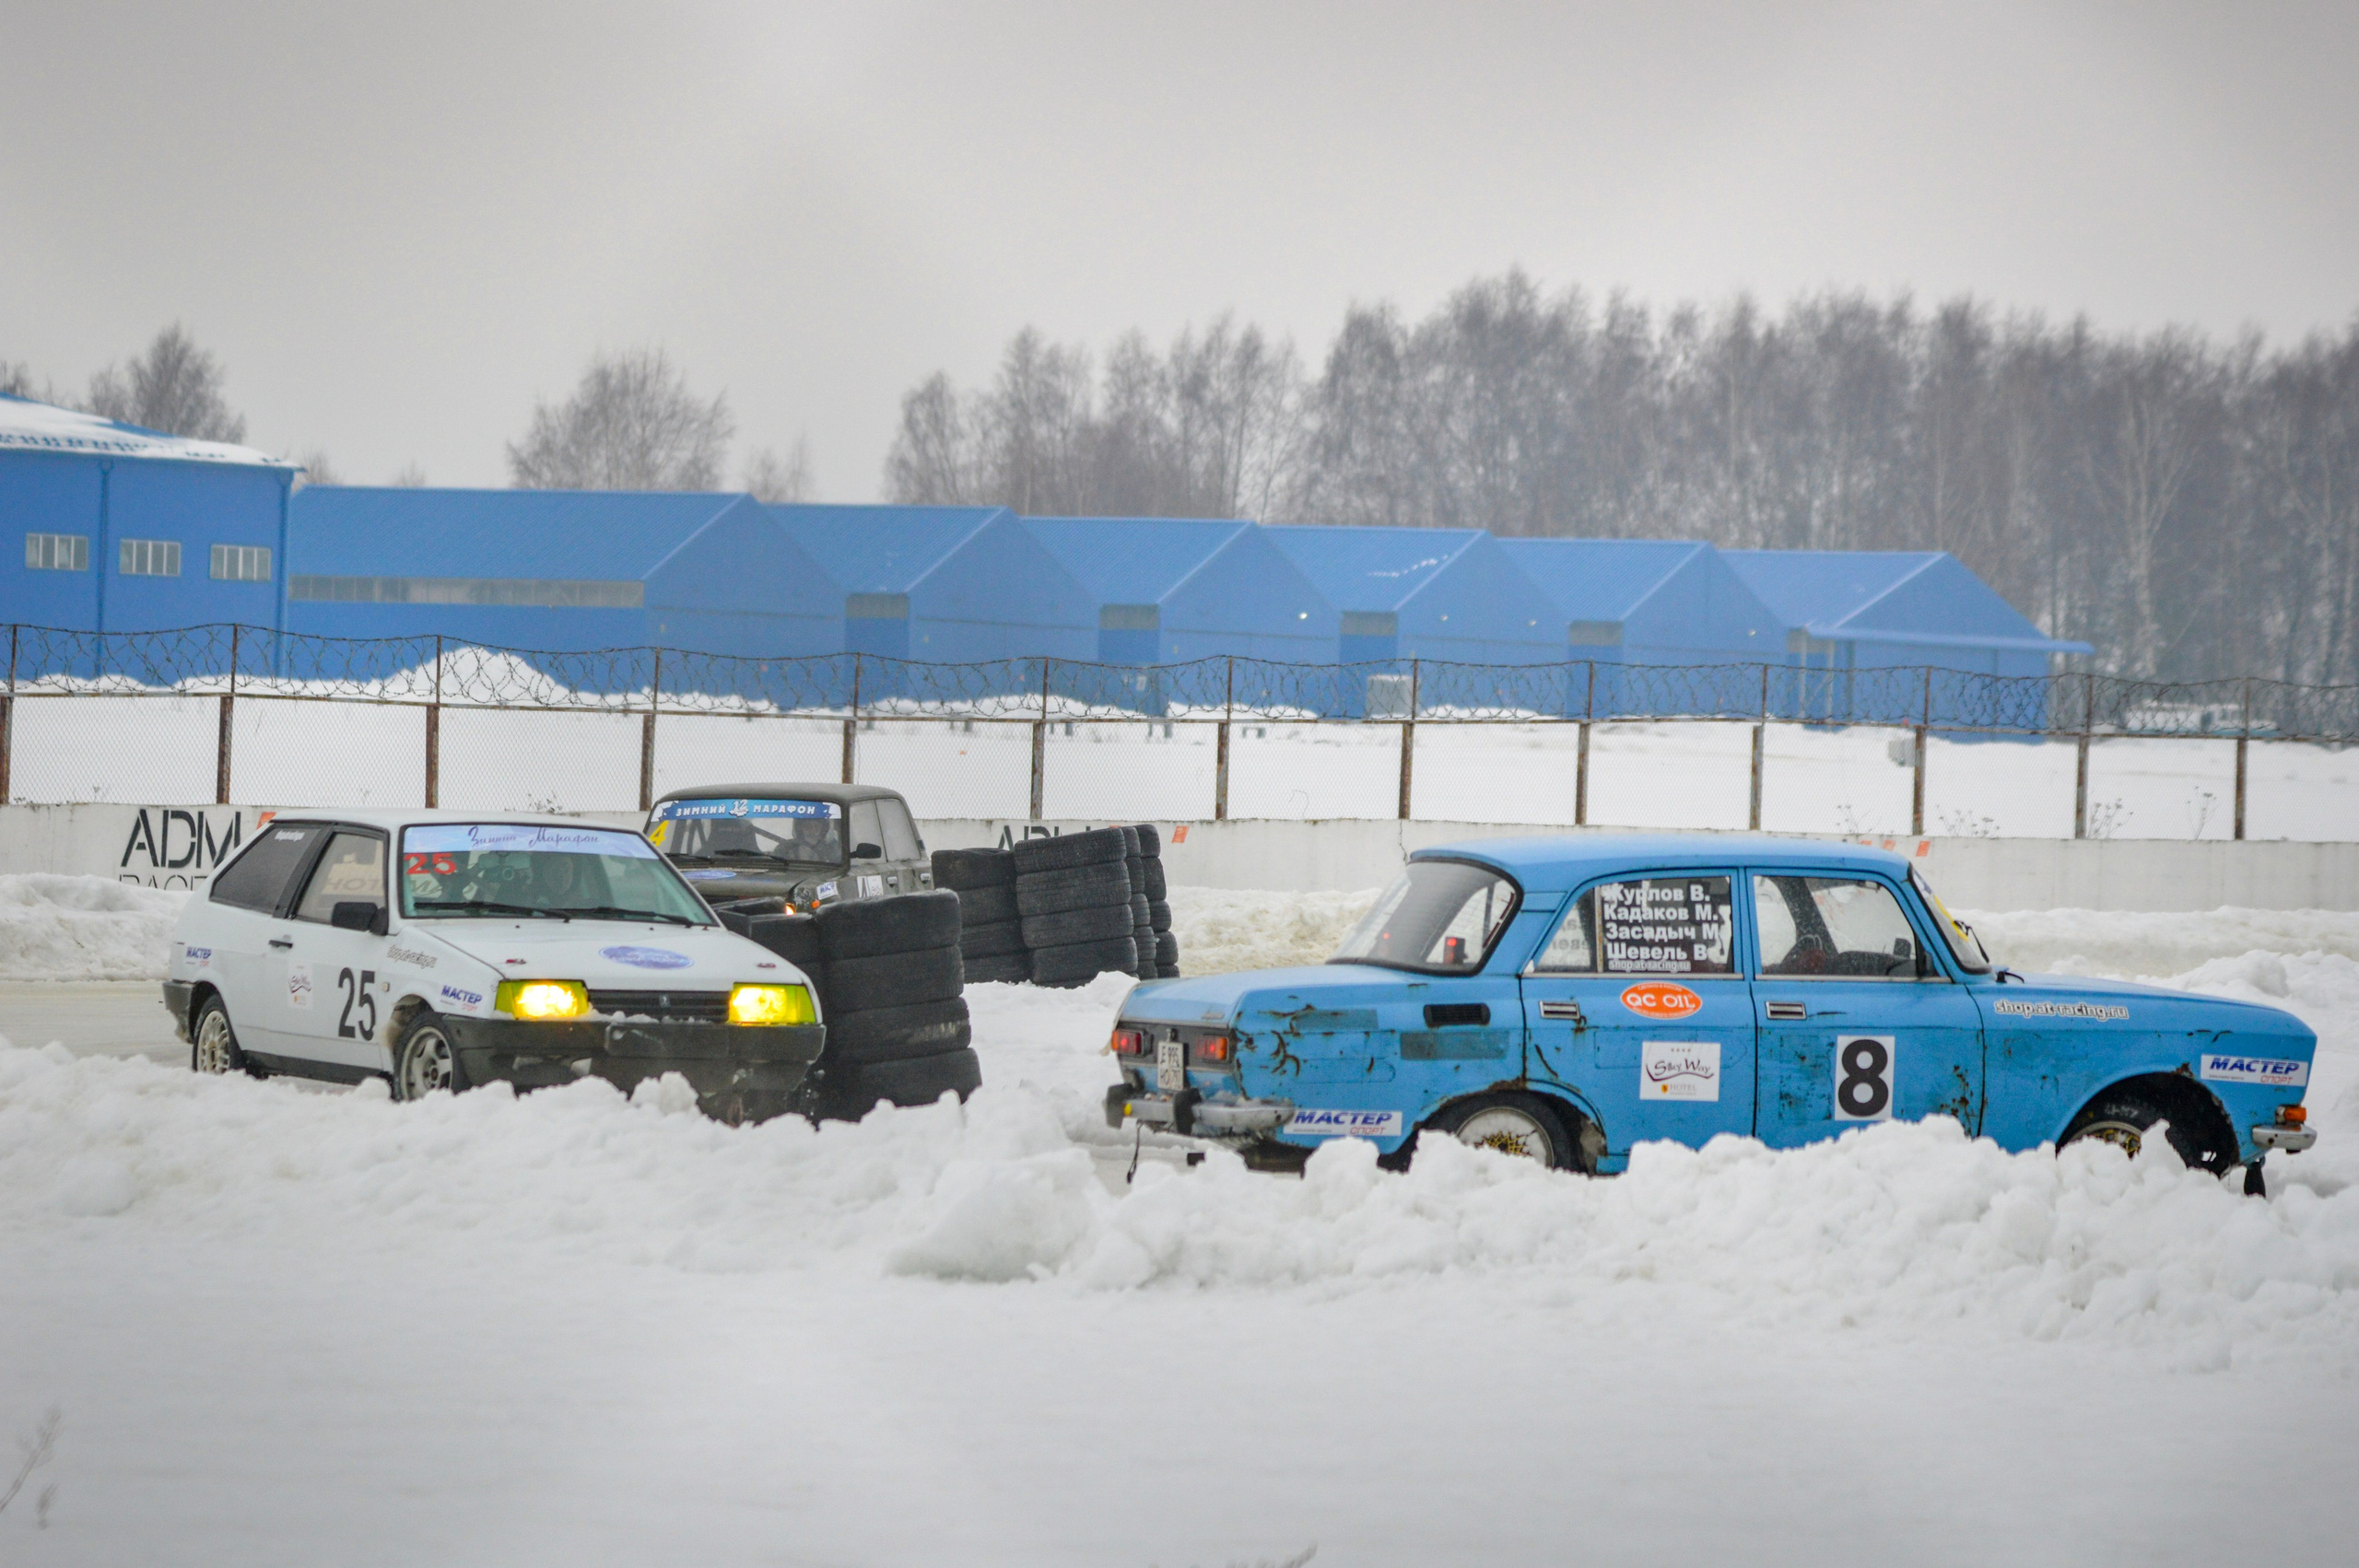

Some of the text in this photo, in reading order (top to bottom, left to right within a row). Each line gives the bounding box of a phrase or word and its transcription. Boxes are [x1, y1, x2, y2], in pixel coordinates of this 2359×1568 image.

[675, 803, 726, 817] ЗИМНИЙ
[752, 805, 816, 815] МАРАФОН
[528, 826, 600, 848] Марафон
[649, 820, 670, 847] 4
[403, 852, 457, 876] 25
[1690, 883, 1711, 903] В.
[1604, 903, 1719, 923] Кадаков М.
[1605, 922, 1696, 942] Засадыч
[1606, 942, 1688, 961] Шевель
[337, 966, 376, 1041] 25
[440, 985, 483, 1004] МАСТЕР
[1626, 993, 1696, 1009] QC OIL
[1994, 999, 2130, 1022] shop.at-racing.ru
[2210, 1057, 2300, 1075] МАСТЕР
[1837, 1038, 1889, 1117] 8
[2260, 1075, 2294, 1084] СПОРТ
[1670, 1083, 1697, 1092] HOTEL
[1294, 1111, 1393, 1126] МАСТЕР
[1350, 1127, 1386, 1135] СПОРТ
